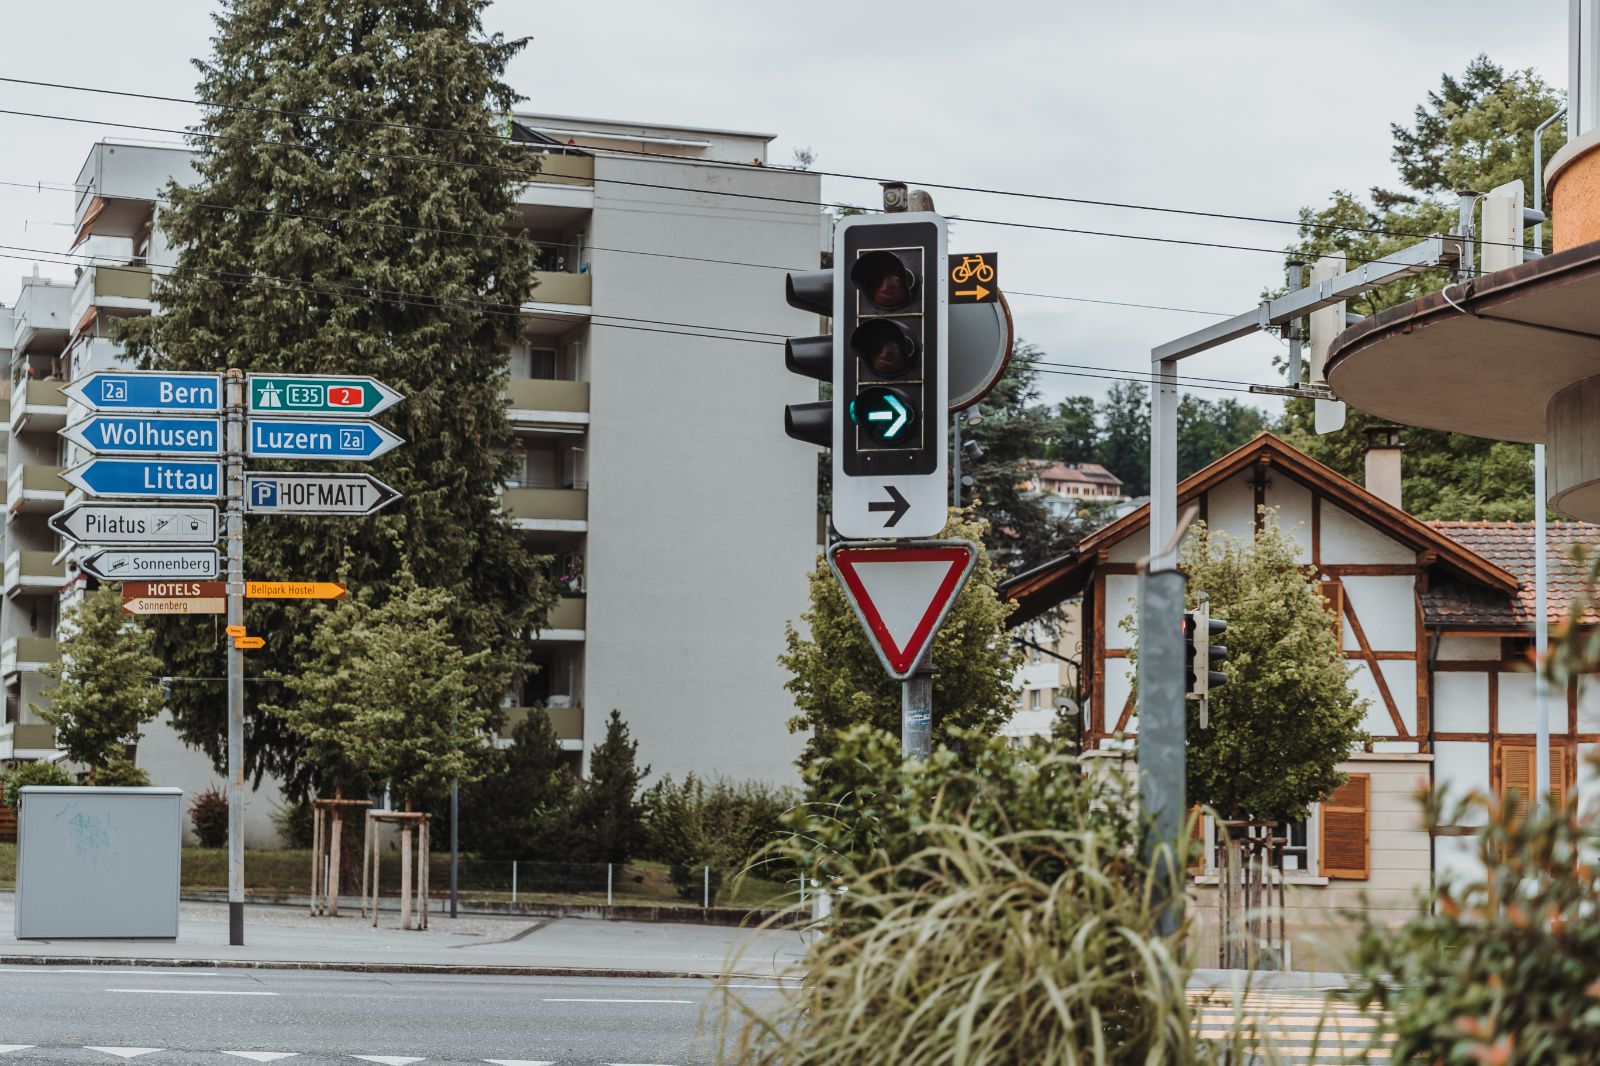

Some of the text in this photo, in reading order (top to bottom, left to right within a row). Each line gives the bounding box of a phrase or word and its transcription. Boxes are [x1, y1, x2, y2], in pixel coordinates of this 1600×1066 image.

[105, 381, 213, 404] 2a Bern
[292, 387, 319, 403] E35
[341, 389, 350, 404] 2
[100, 421, 214, 447] Wolhusen
[257, 426, 361, 450] Luzern 2a
[145, 465, 213, 490] Littau
[258, 483, 367, 506] P HOFMATT
[86, 514, 146, 534] Pilatus
[133, 557, 211, 573] Sonnenberg
[148, 583, 201, 596] HOTELS
[251, 584, 315, 597] Bellpark Hostel
[138, 600, 188, 612] Sonnenberg
